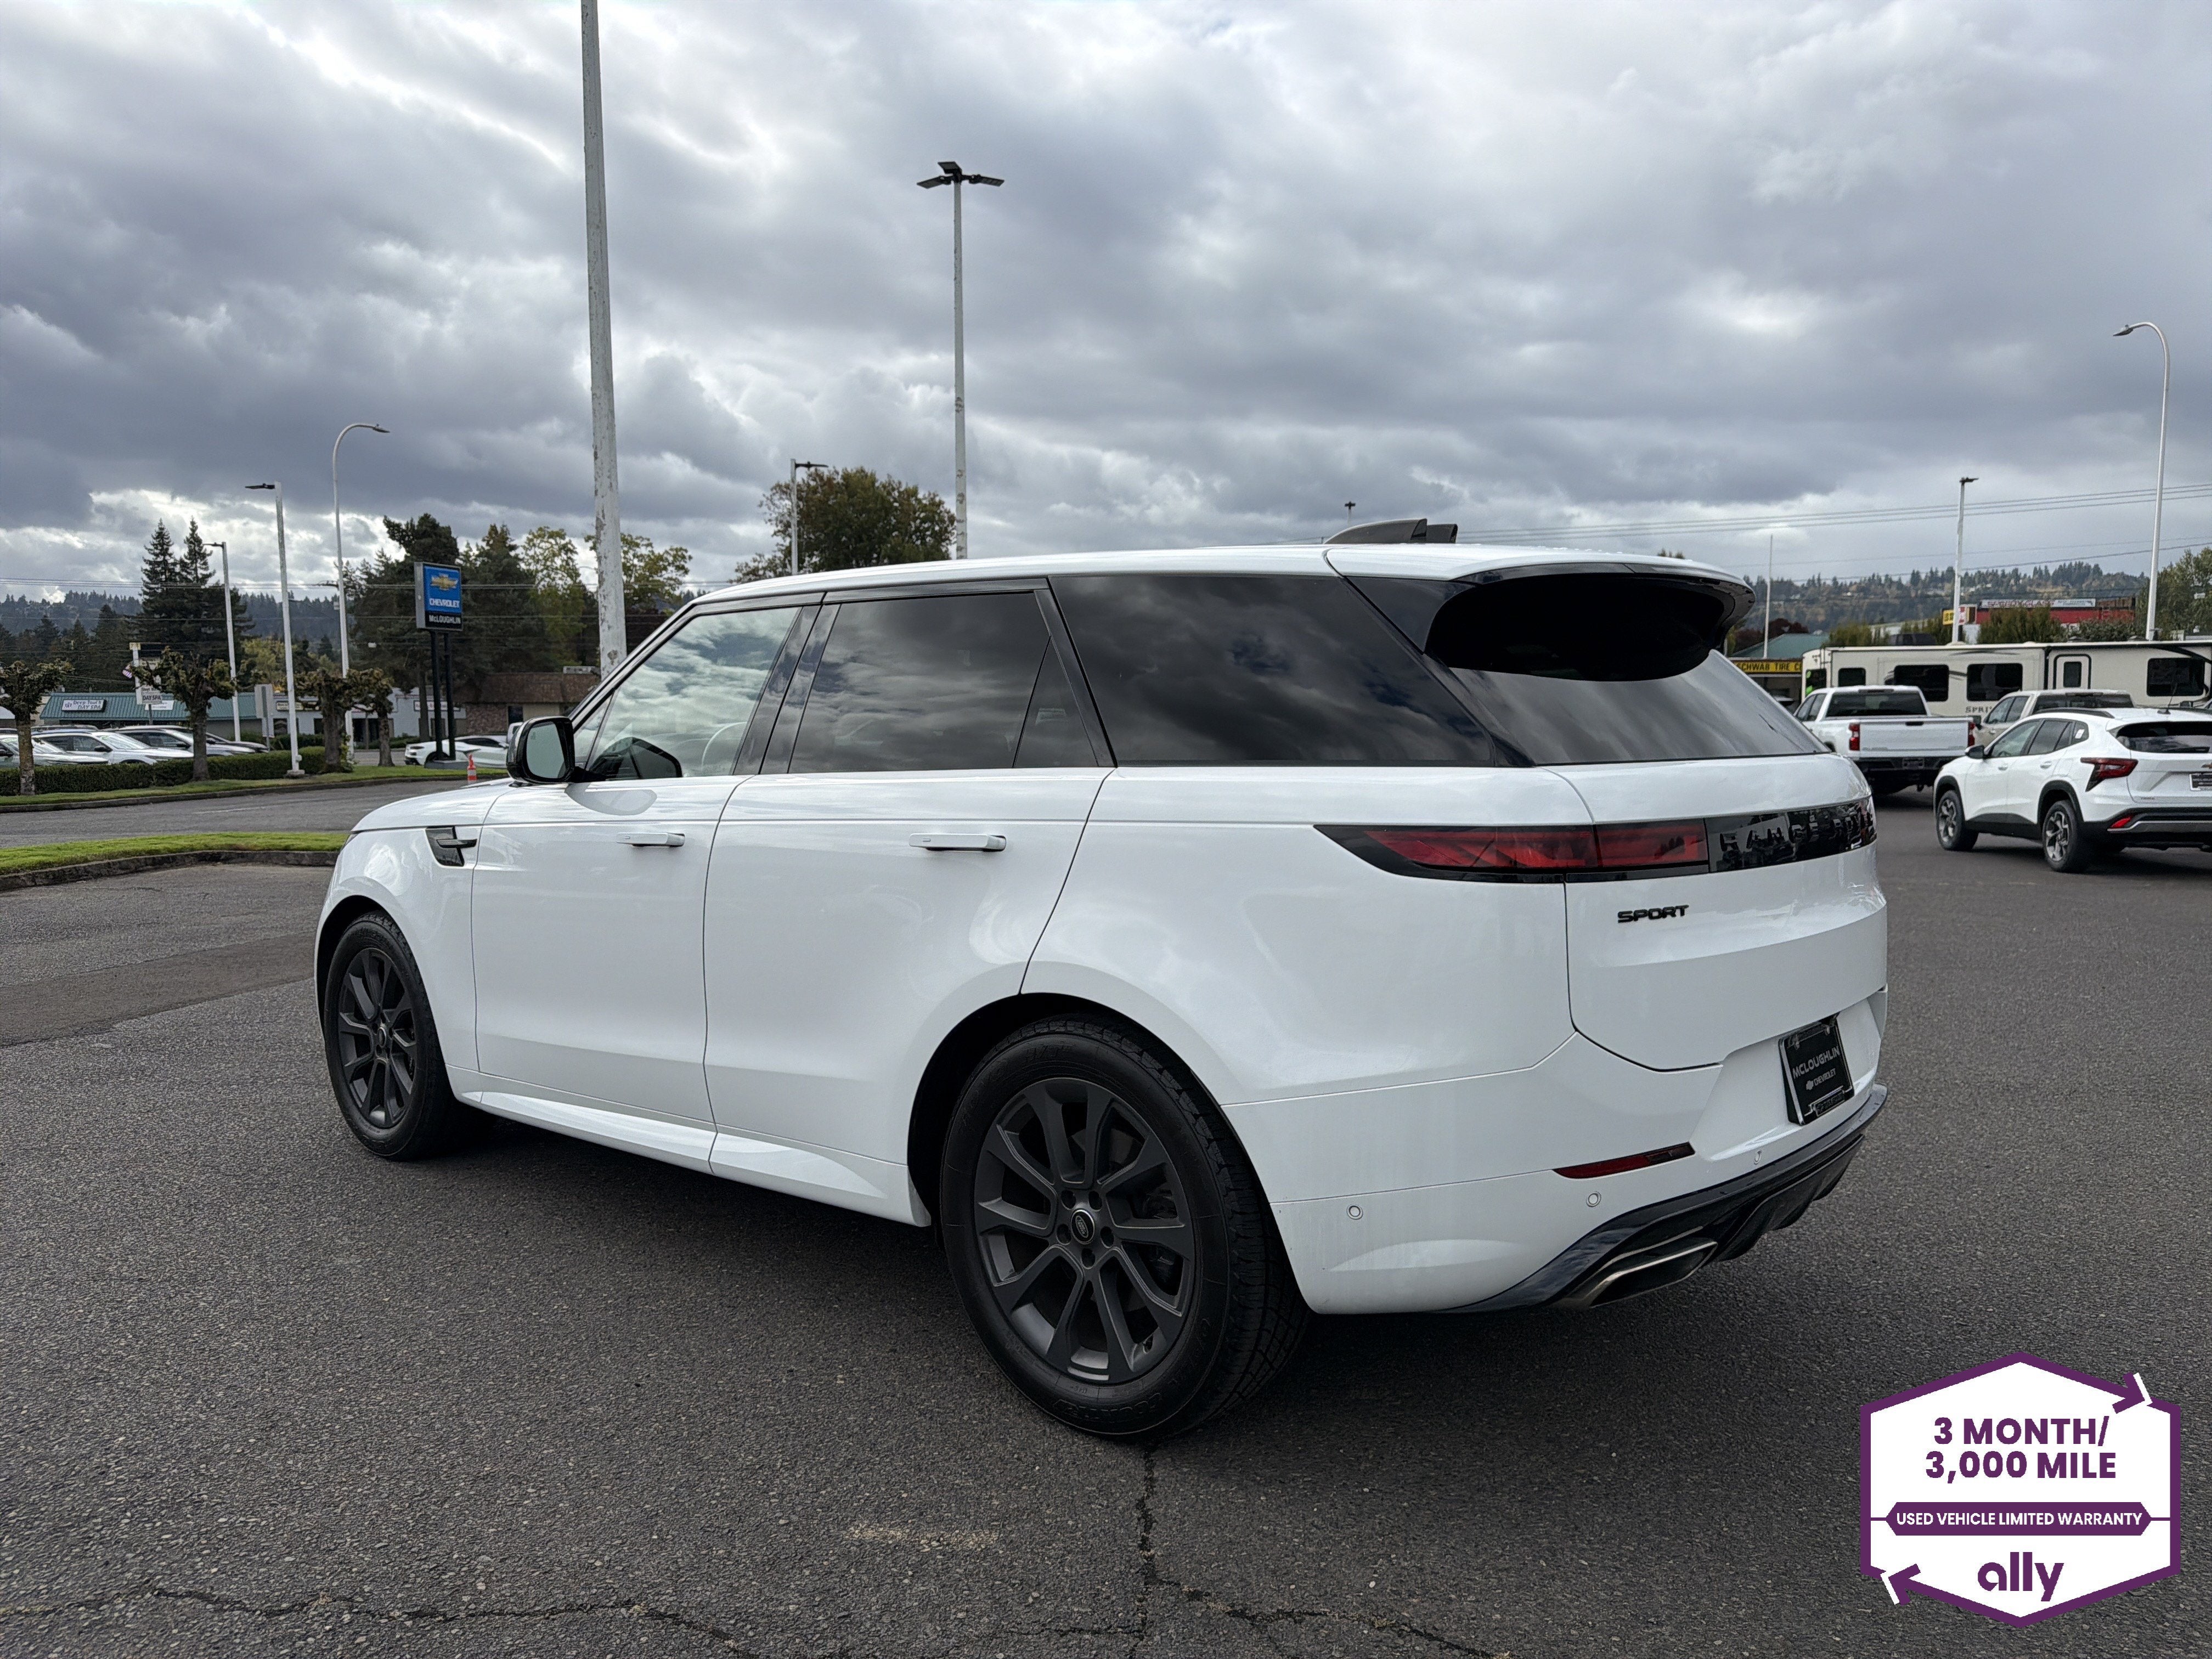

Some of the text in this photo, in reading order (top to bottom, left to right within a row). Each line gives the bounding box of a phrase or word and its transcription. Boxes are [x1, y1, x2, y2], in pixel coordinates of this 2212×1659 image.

[429, 598, 460, 608] CHEVROLET
[1774, 662, 1791, 670] TIRE
[1618, 905, 1689, 923] SPORT
[1792, 1046, 1840, 1079] MCLOUGHLIN
[1813, 1068, 1836, 1086] CHEVROLET
